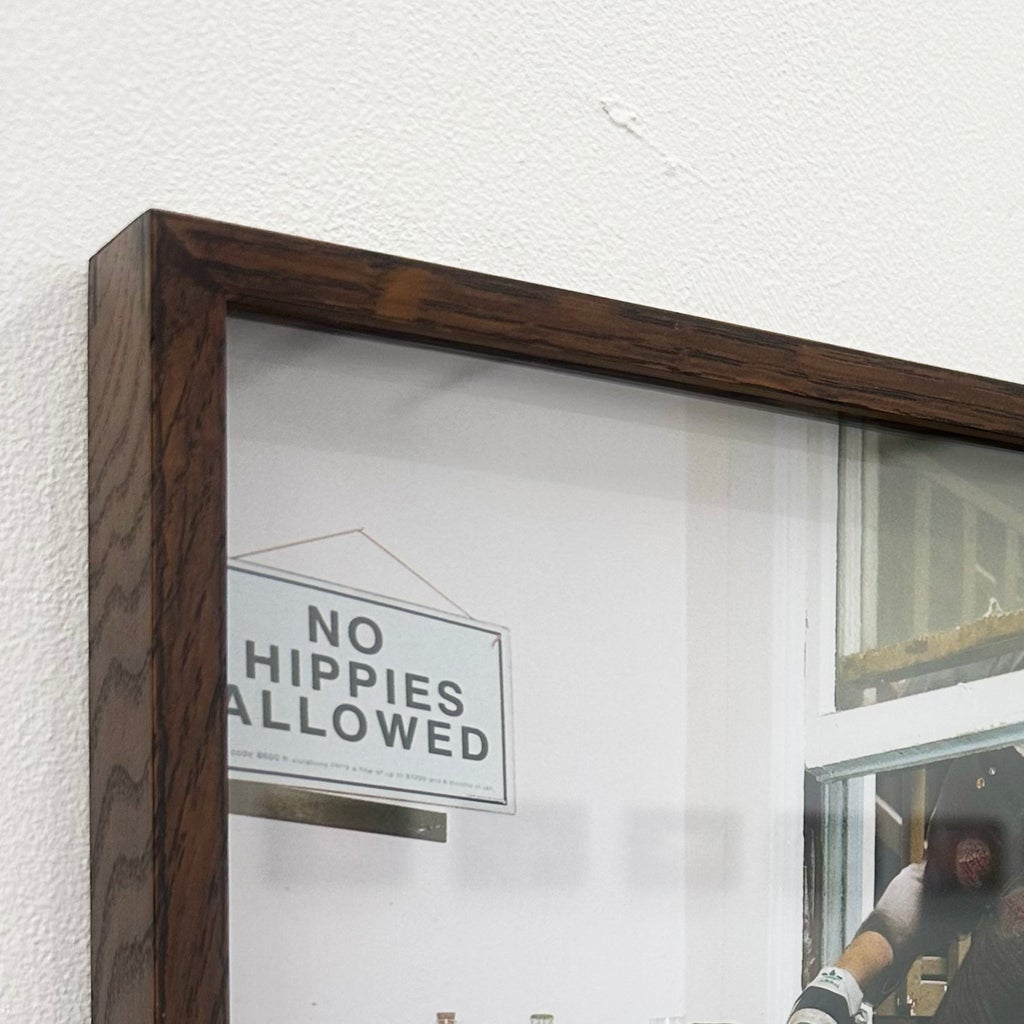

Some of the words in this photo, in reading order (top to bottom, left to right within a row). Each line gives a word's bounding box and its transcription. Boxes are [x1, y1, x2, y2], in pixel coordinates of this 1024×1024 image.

[308, 605, 383, 655] NO
[245, 640, 464, 717] HIPPIES
[228, 683, 489, 761] ALLOWED
